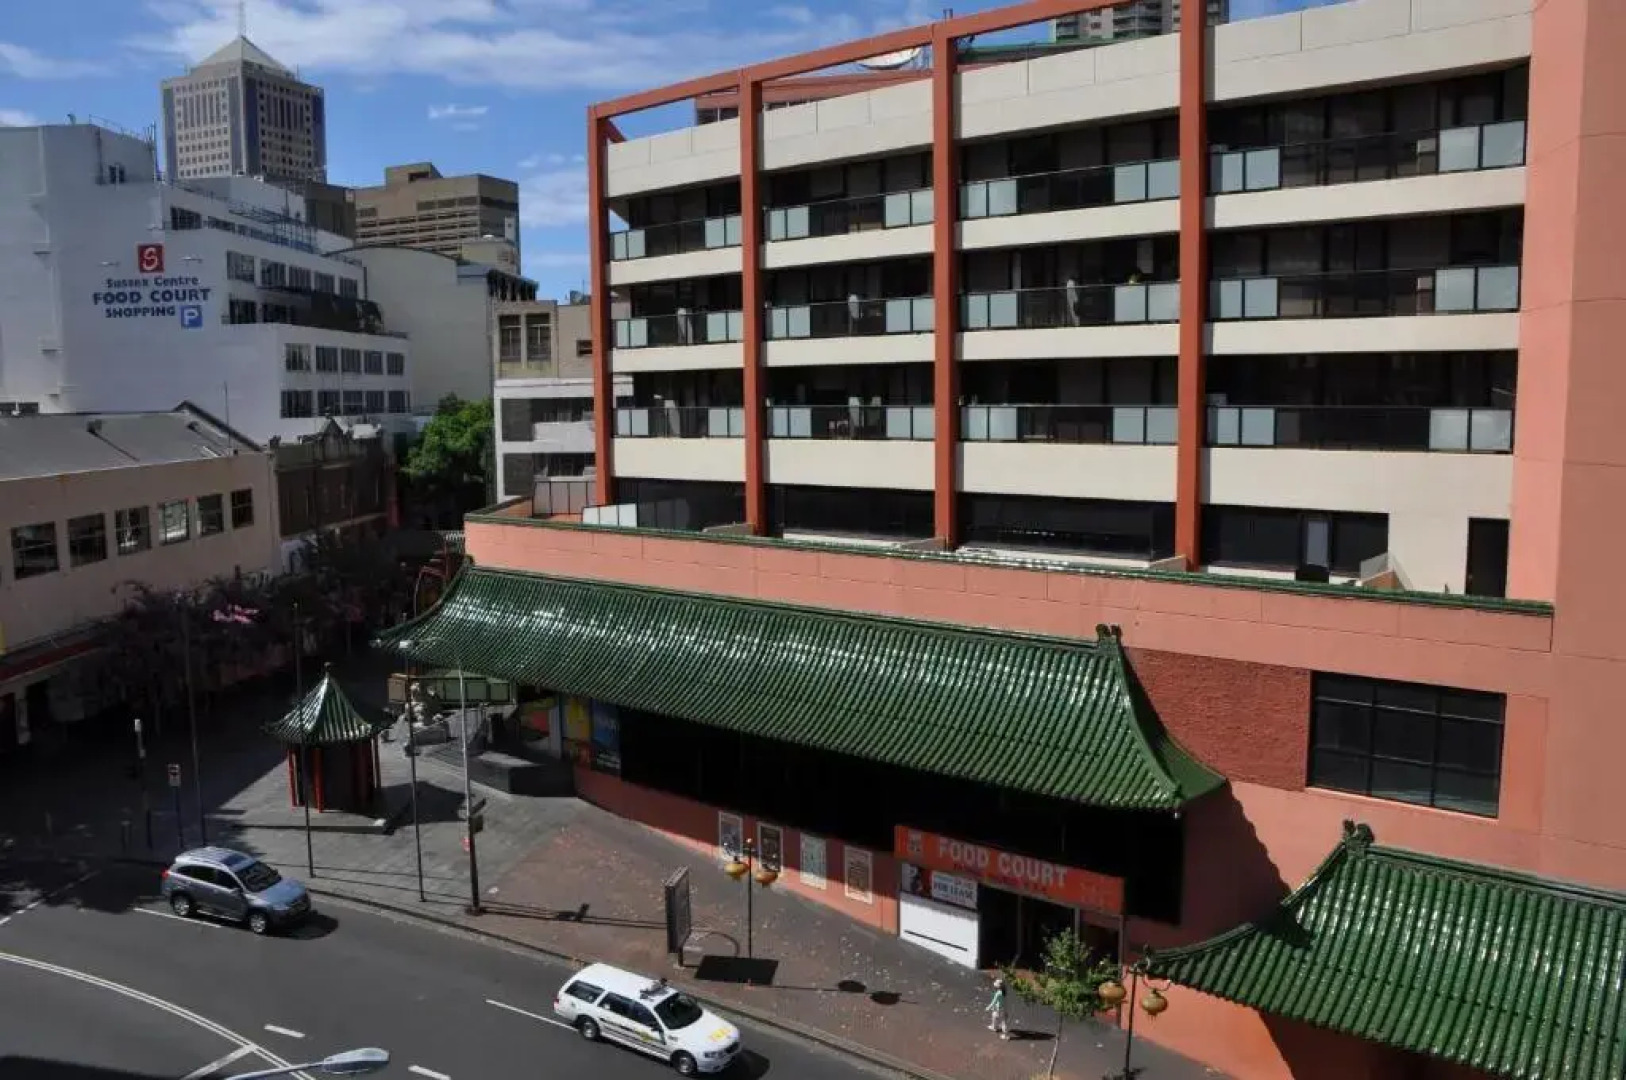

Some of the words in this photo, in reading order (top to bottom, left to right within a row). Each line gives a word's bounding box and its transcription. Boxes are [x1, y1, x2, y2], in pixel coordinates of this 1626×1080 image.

[143, 247, 158, 271] S
[154, 275, 199, 287] Centre
[93, 291, 142, 305] FOOD
[150, 288, 210, 303] COURT
[105, 306, 175, 318] SHOPPING
[184, 309, 198, 325] P
[938, 835, 990, 868] FOOD
[998, 853, 1067, 887] COURT
